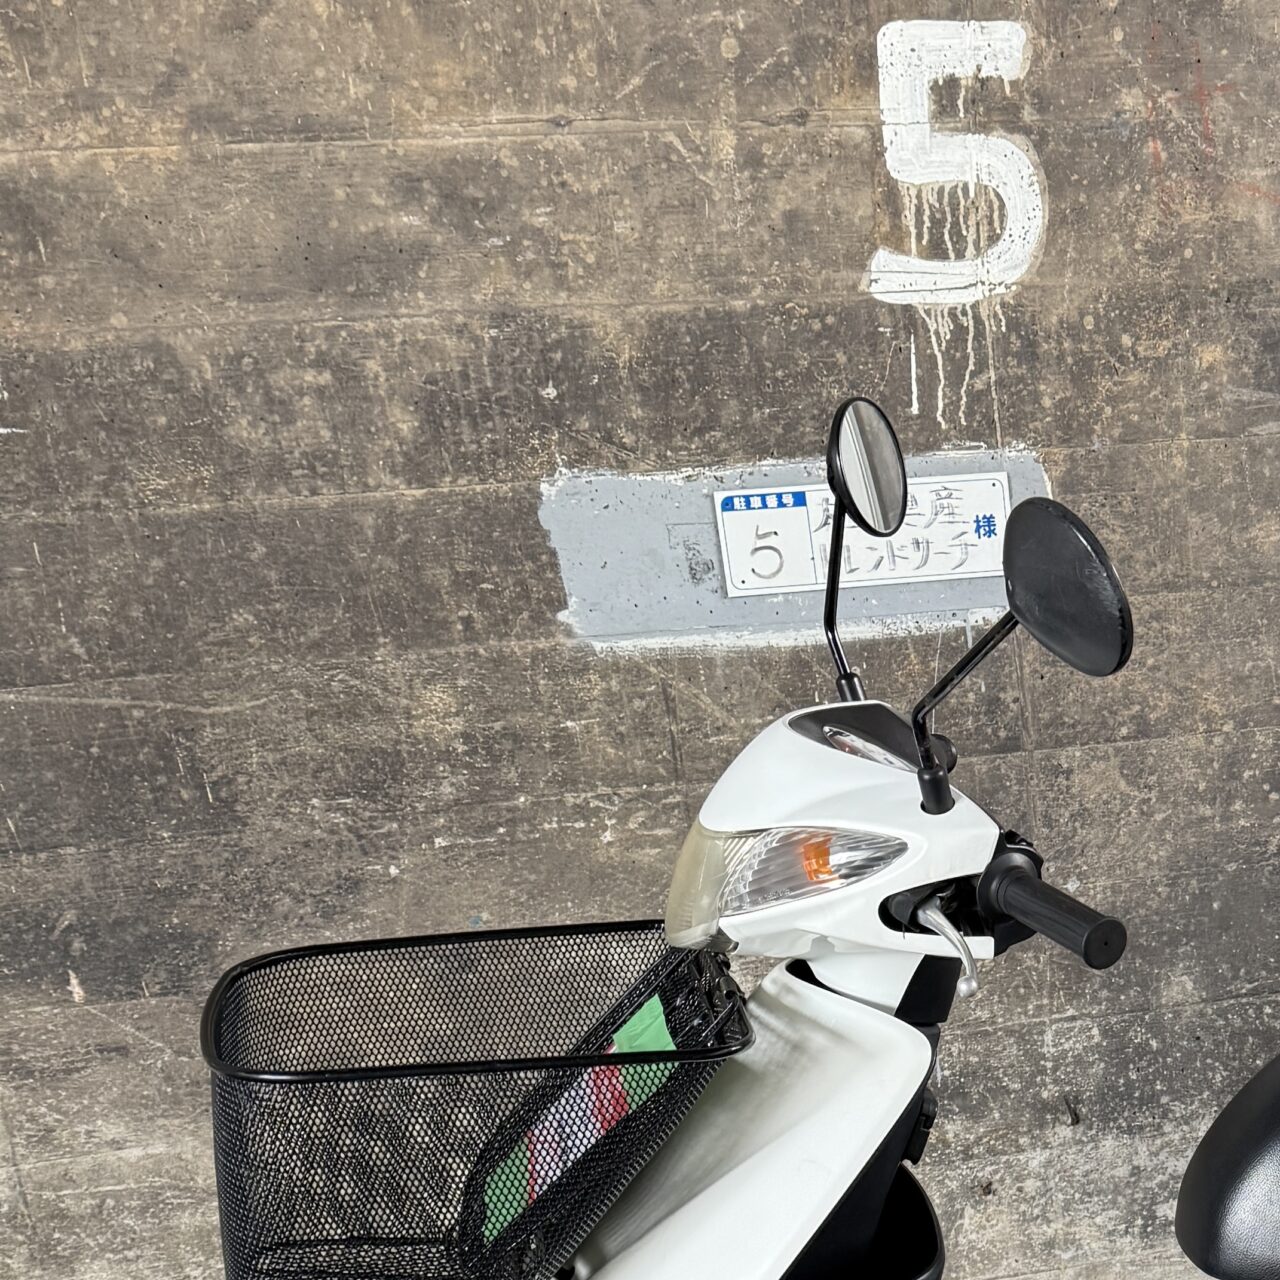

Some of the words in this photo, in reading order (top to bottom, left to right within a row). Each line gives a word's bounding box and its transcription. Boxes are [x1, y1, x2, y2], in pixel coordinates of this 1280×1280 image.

[868, 19, 1045, 304] 5
[733, 493, 795, 510] 駐車番号
[973, 513, 998, 540] 様
[750, 524, 785, 580] 5
